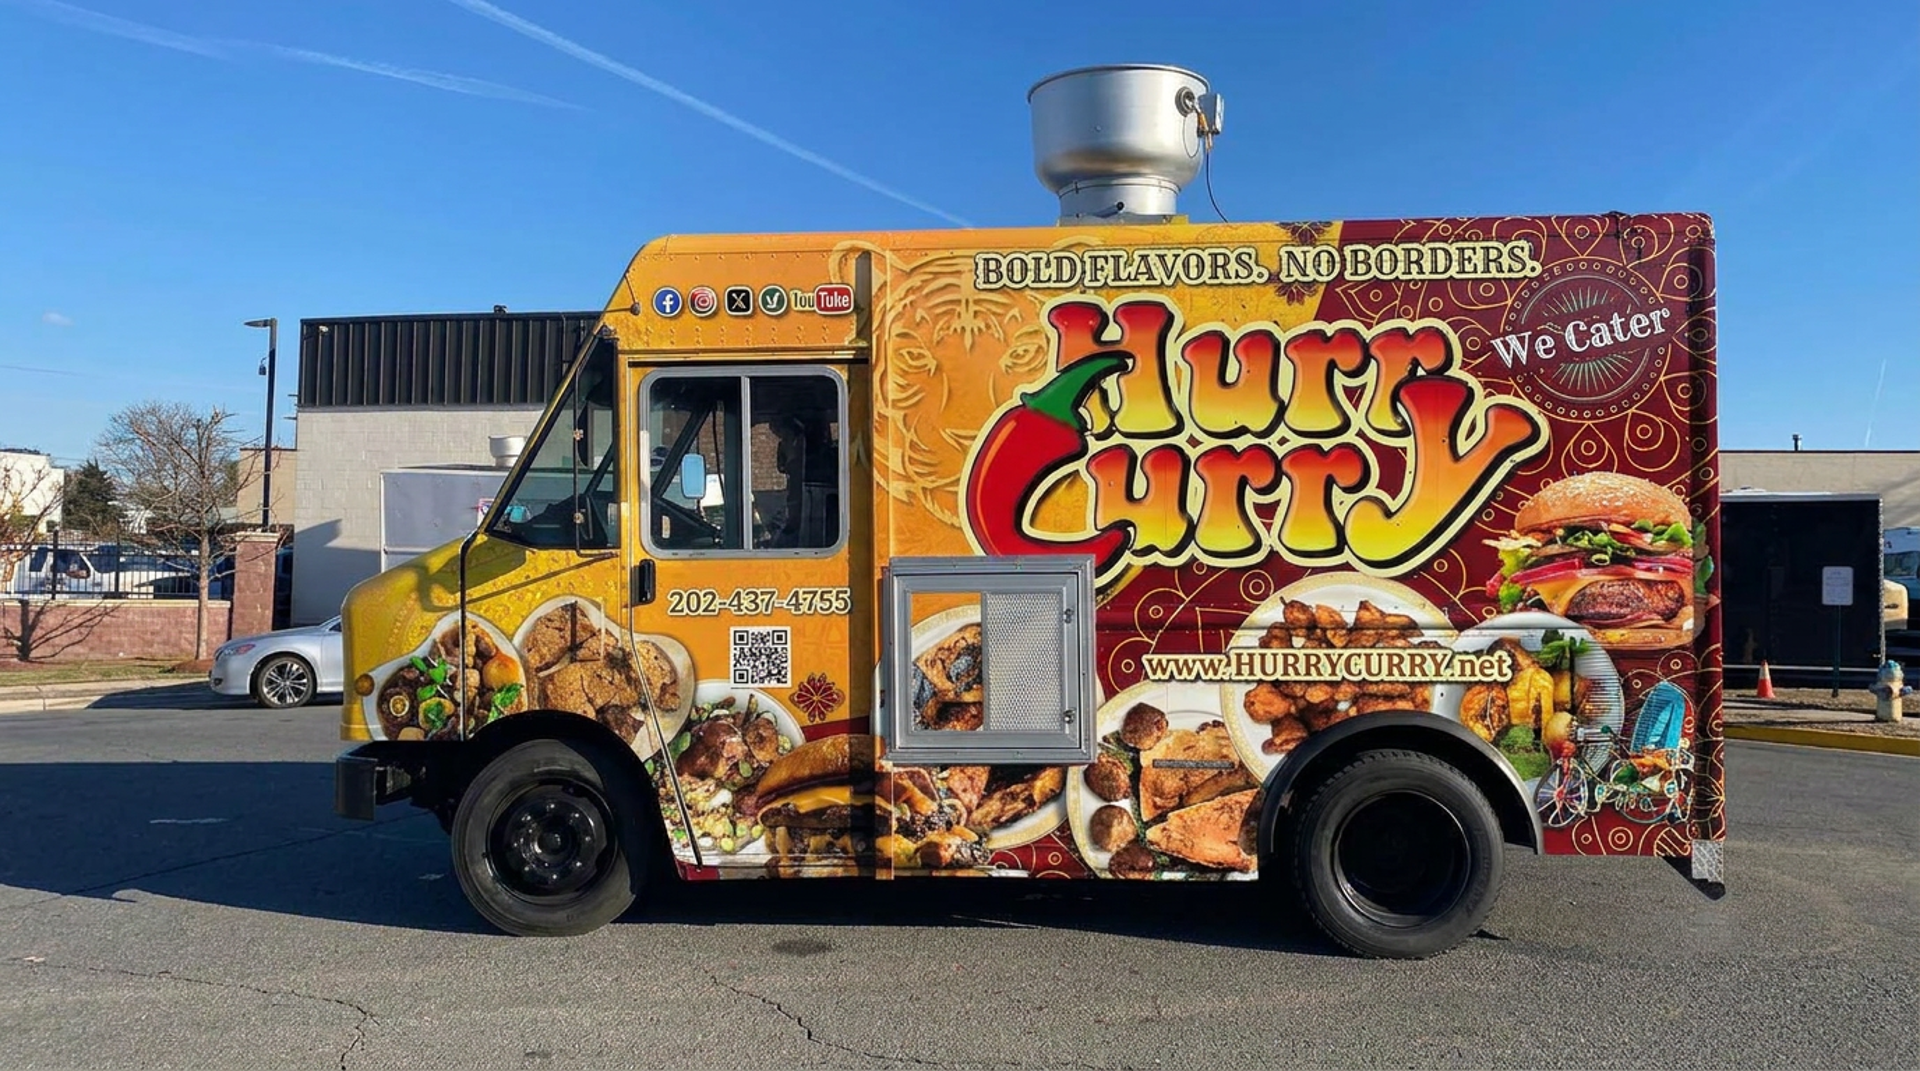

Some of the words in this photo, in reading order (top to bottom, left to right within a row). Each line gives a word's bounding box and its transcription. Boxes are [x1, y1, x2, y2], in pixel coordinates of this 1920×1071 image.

[981, 254, 1079, 286] BOLD
[1087, 250, 1267, 285] FLAVORS.
[1284, 248, 1338, 278] NO
[1349, 244, 1539, 277] BORDERS.
[1490, 330, 1557, 369] We
[1564, 307, 1671, 353] Cater
[669, 590, 850, 614] 202-437-4755
